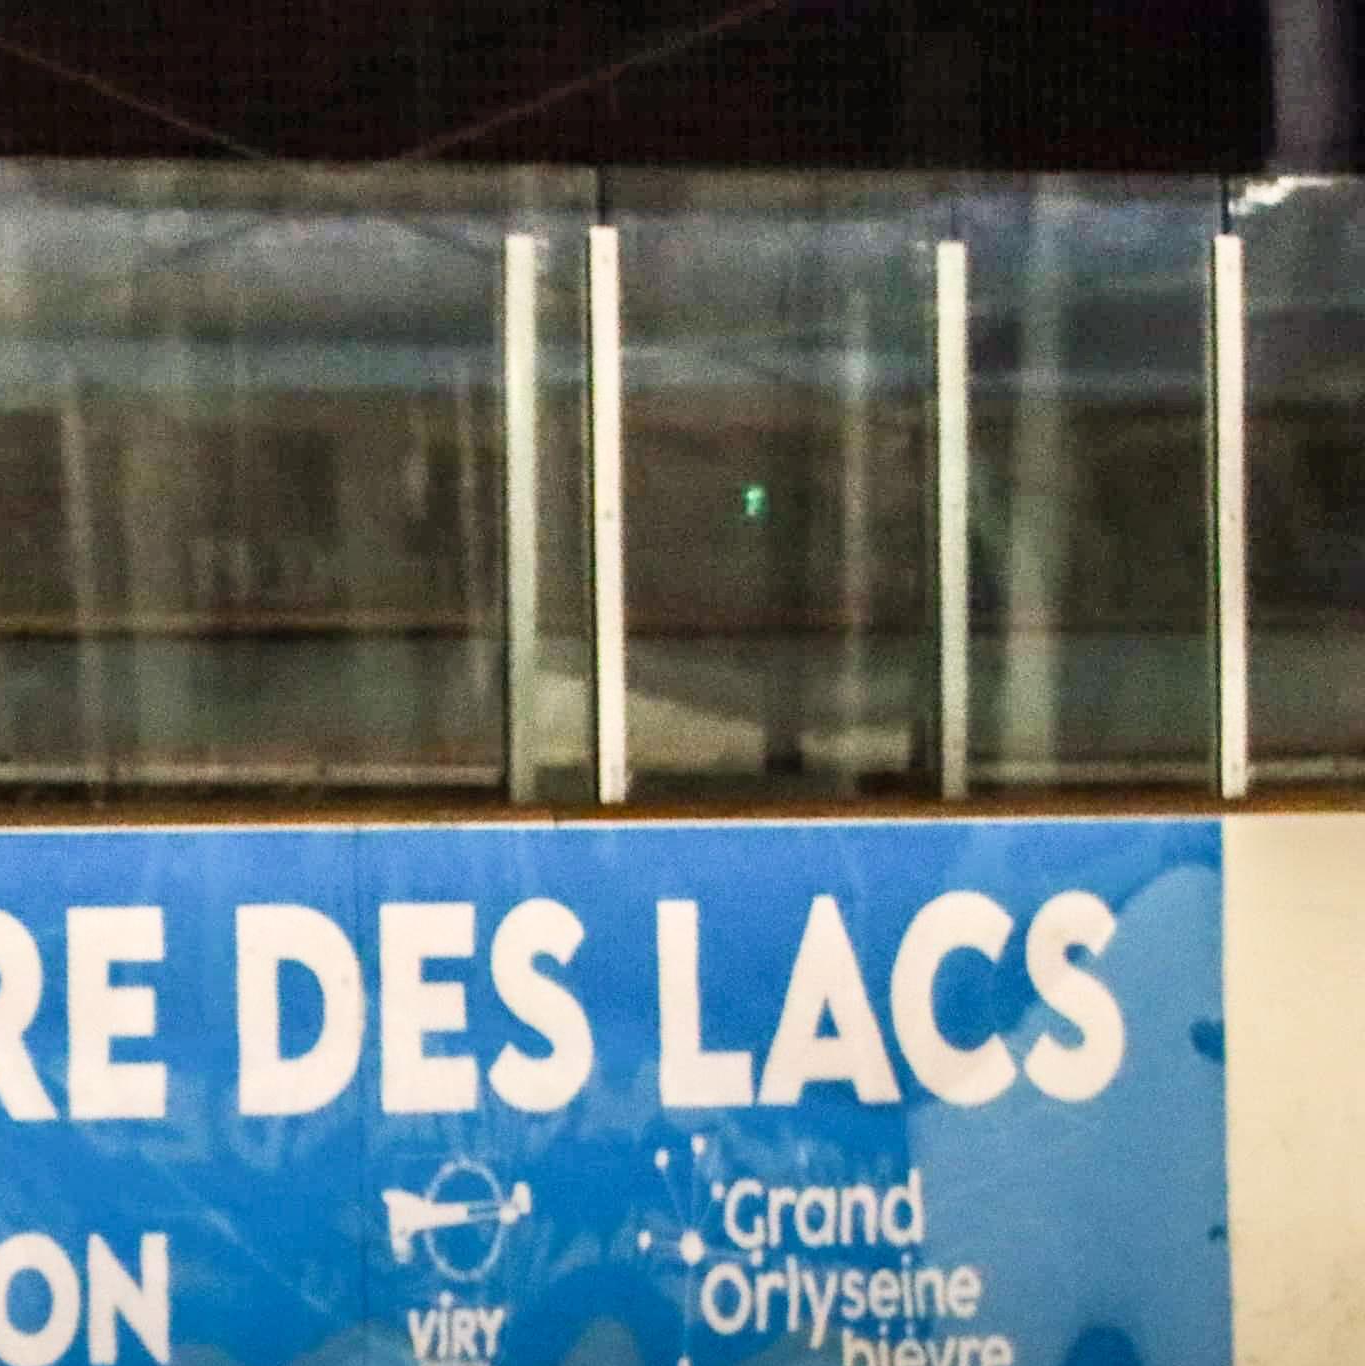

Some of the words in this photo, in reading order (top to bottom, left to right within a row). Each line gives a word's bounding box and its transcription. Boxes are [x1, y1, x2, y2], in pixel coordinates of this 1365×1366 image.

[235, 897, 595, 1117] DES
[656, 890, 1126, 1108] LACS
[724, 1167, 926, 1249] Grand
